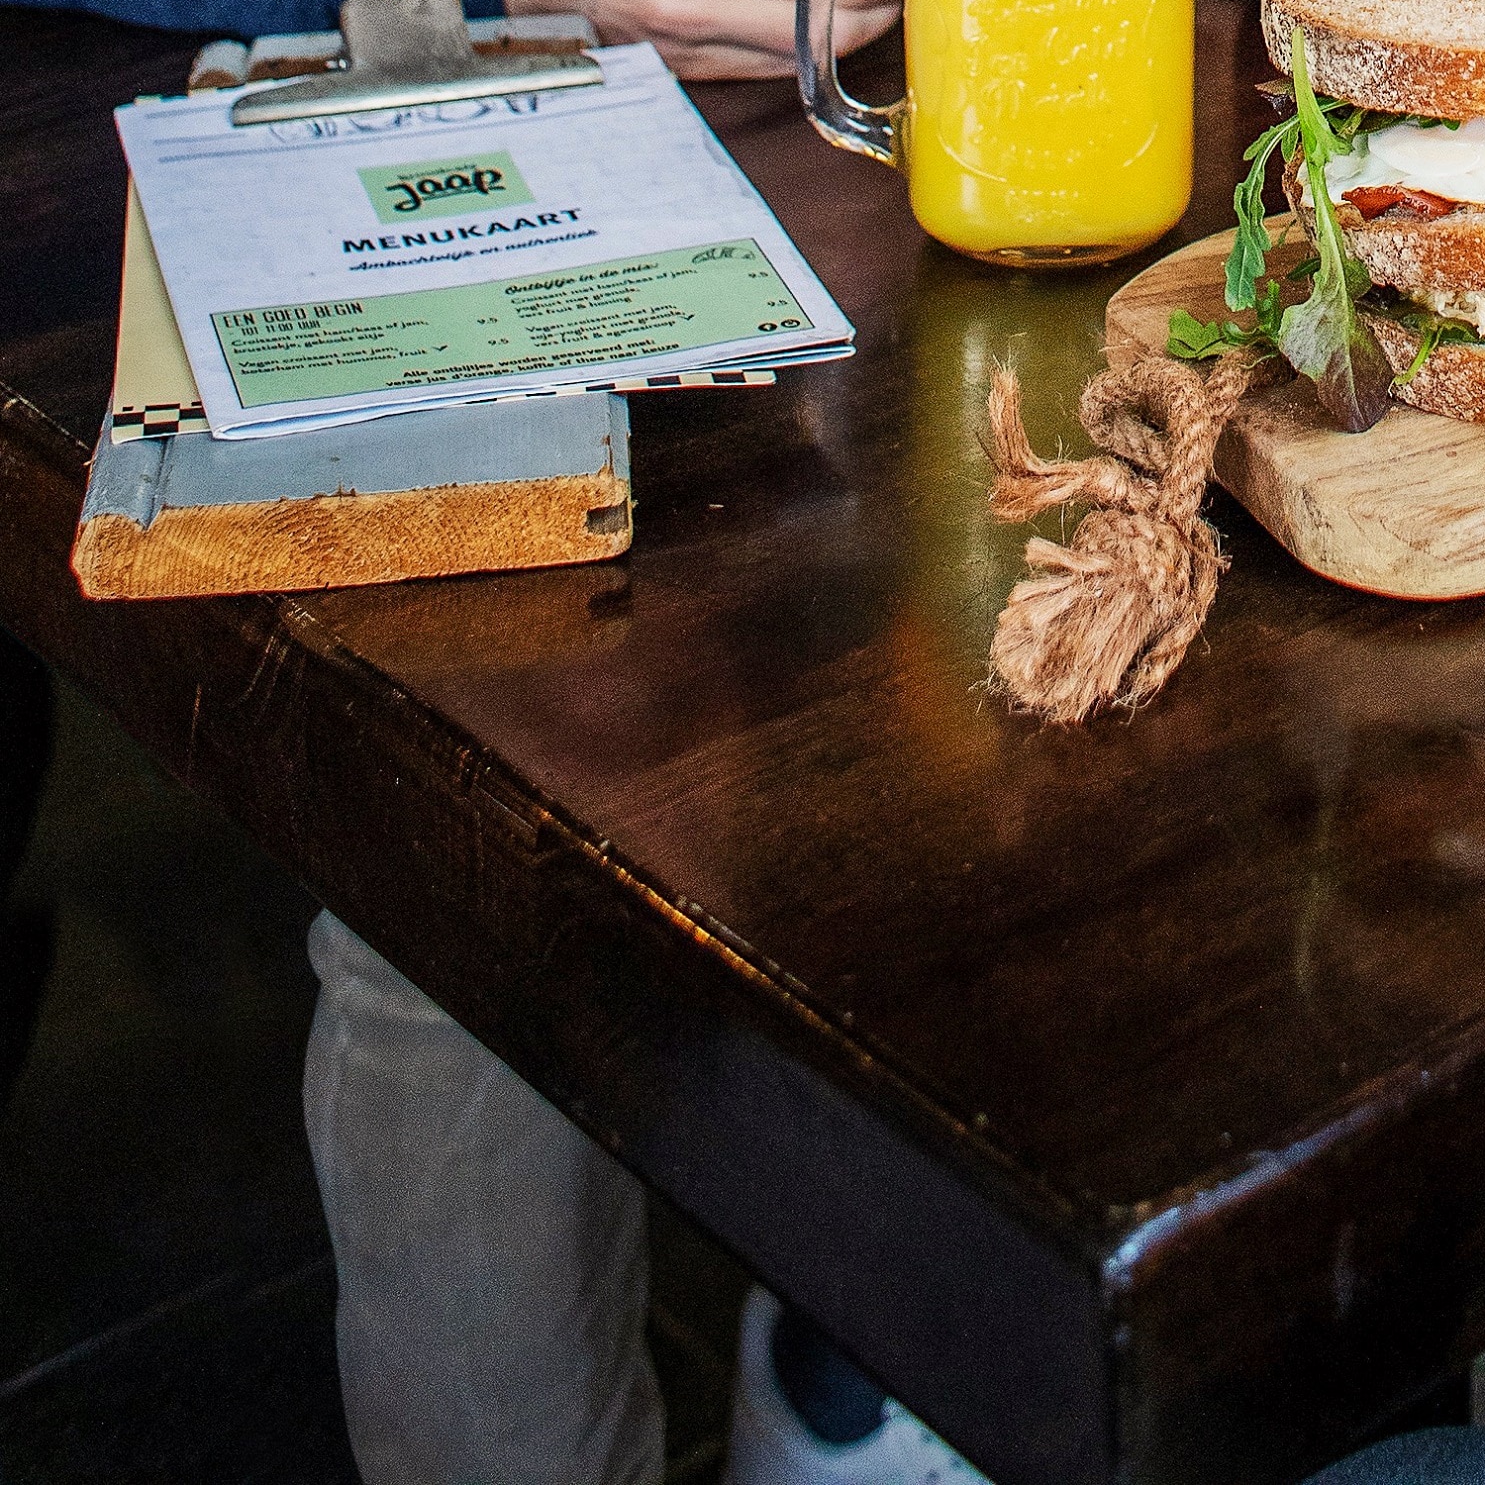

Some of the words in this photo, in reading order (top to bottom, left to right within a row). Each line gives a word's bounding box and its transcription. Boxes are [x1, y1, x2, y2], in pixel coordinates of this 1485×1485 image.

[385, 165, 505, 212] jaap
[342, 208, 581, 253] MENUKAART
[479, 245, 501, 256] en
[579, 274, 595, 282] in
[599, 269, 619, 279] de
[510, 290, 568, 305] Croissant
[571, 285, 594, 295] met
[597, 276, 653, 290] ham/kaas
[655, 272, 668, 280] of
[223, 313, 255, 328] EEN
[263, 307, 307, 323] GOED
[313, 301, 363, 319] BEGIN
[515, 300, 562, 313] yoghurt
[565, 295, 589, 304] met
[519, 311, 544, 319] vers
[545, 306, 573, 315] fruit
[588, 296, 633, 308] honing
[241, 326, 259, 337] TOT
[297, 319, 321, 331] UUR
[525, 323, 565, 333] Vegan
[567, 313, 620, 327] croissant
[623, 309, 647, 318] met
[610, 319, 634, 328] met
[231, 335, 291, 347] Croissant
[294, 331, 321, 340] met
[322, 327, 383, 336] ham/kaas
[385, 322, 398, 330] of
[304, 336, 353, 348] gekookt
[357, 332, 385, 341] eitje
[533, 340, 560, 348] vers
[561, 334, 589, 344] fruit
[238, 359, 280, 368] Vegan
[282, 353, 339, 363] croissant
[342, 349, 368, 358] met
[240, 363, 305, 375] boterham
[308, 360, 333, 369] met
[399, 349, 428, 358] fruit
[385, 378, 422, 387] verse
[426, 376, 447, 384] jus
[517, 361, 555, 372] koffie
[559, 357, 571, 366] of
[575, 354, 605, 365] thee
[609, 350, 637, 360] naar
[641, 343, 679, 355] keuze
[403, 370, 429, 378] Alle
[433, 363, 494, 375] ontbijtjes
[498, 355, 547, 367] worden
[551, 343, 623, 361] geserveerd
